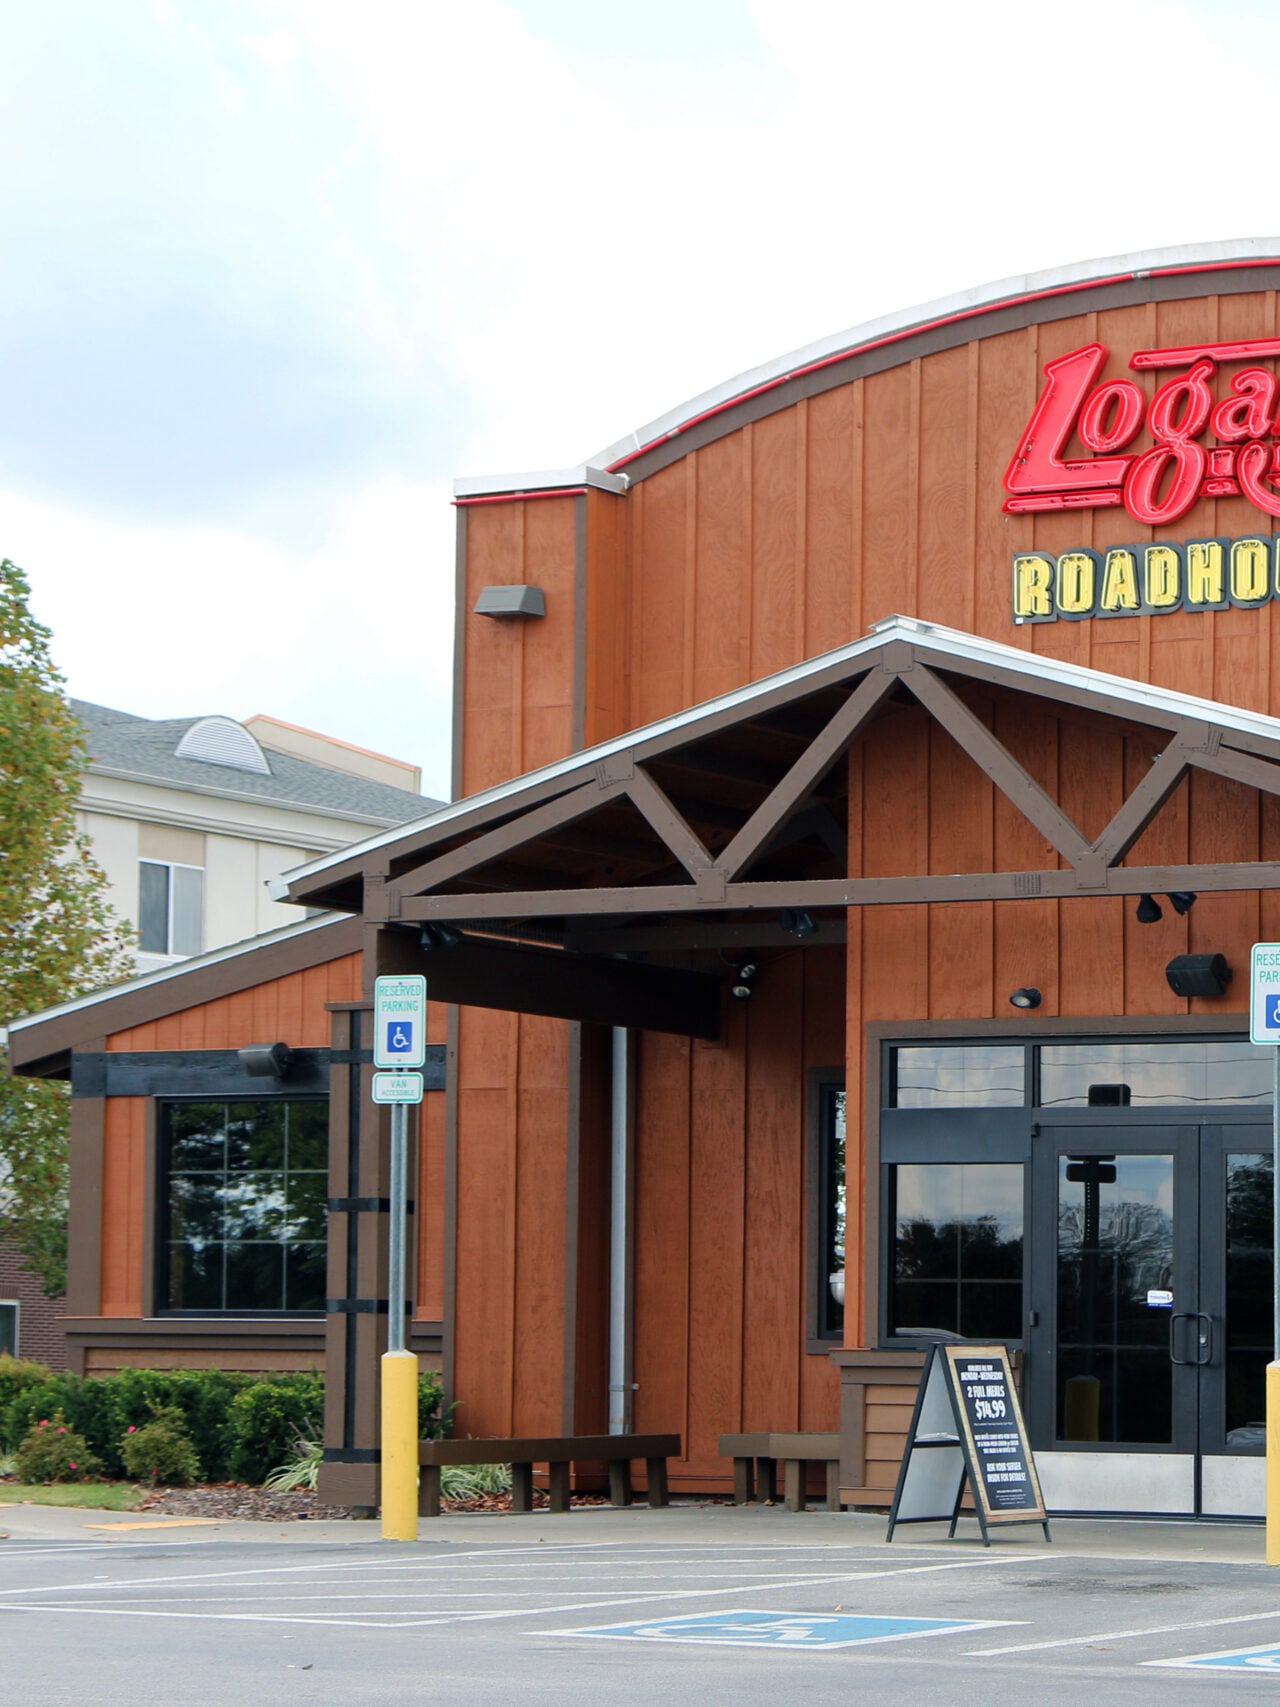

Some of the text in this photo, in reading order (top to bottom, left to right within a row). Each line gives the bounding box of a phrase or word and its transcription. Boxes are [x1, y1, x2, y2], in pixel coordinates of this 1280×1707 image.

[379, 985, 421, 997] RESERVED
[381, 1000, 419, 1012] PARKING
[390, 1080, 407, 1088] VAN
[967, 1384, 1005, 1398] 2 FULL MEALS
[975, 1398, 1006, 1420] $14.99
